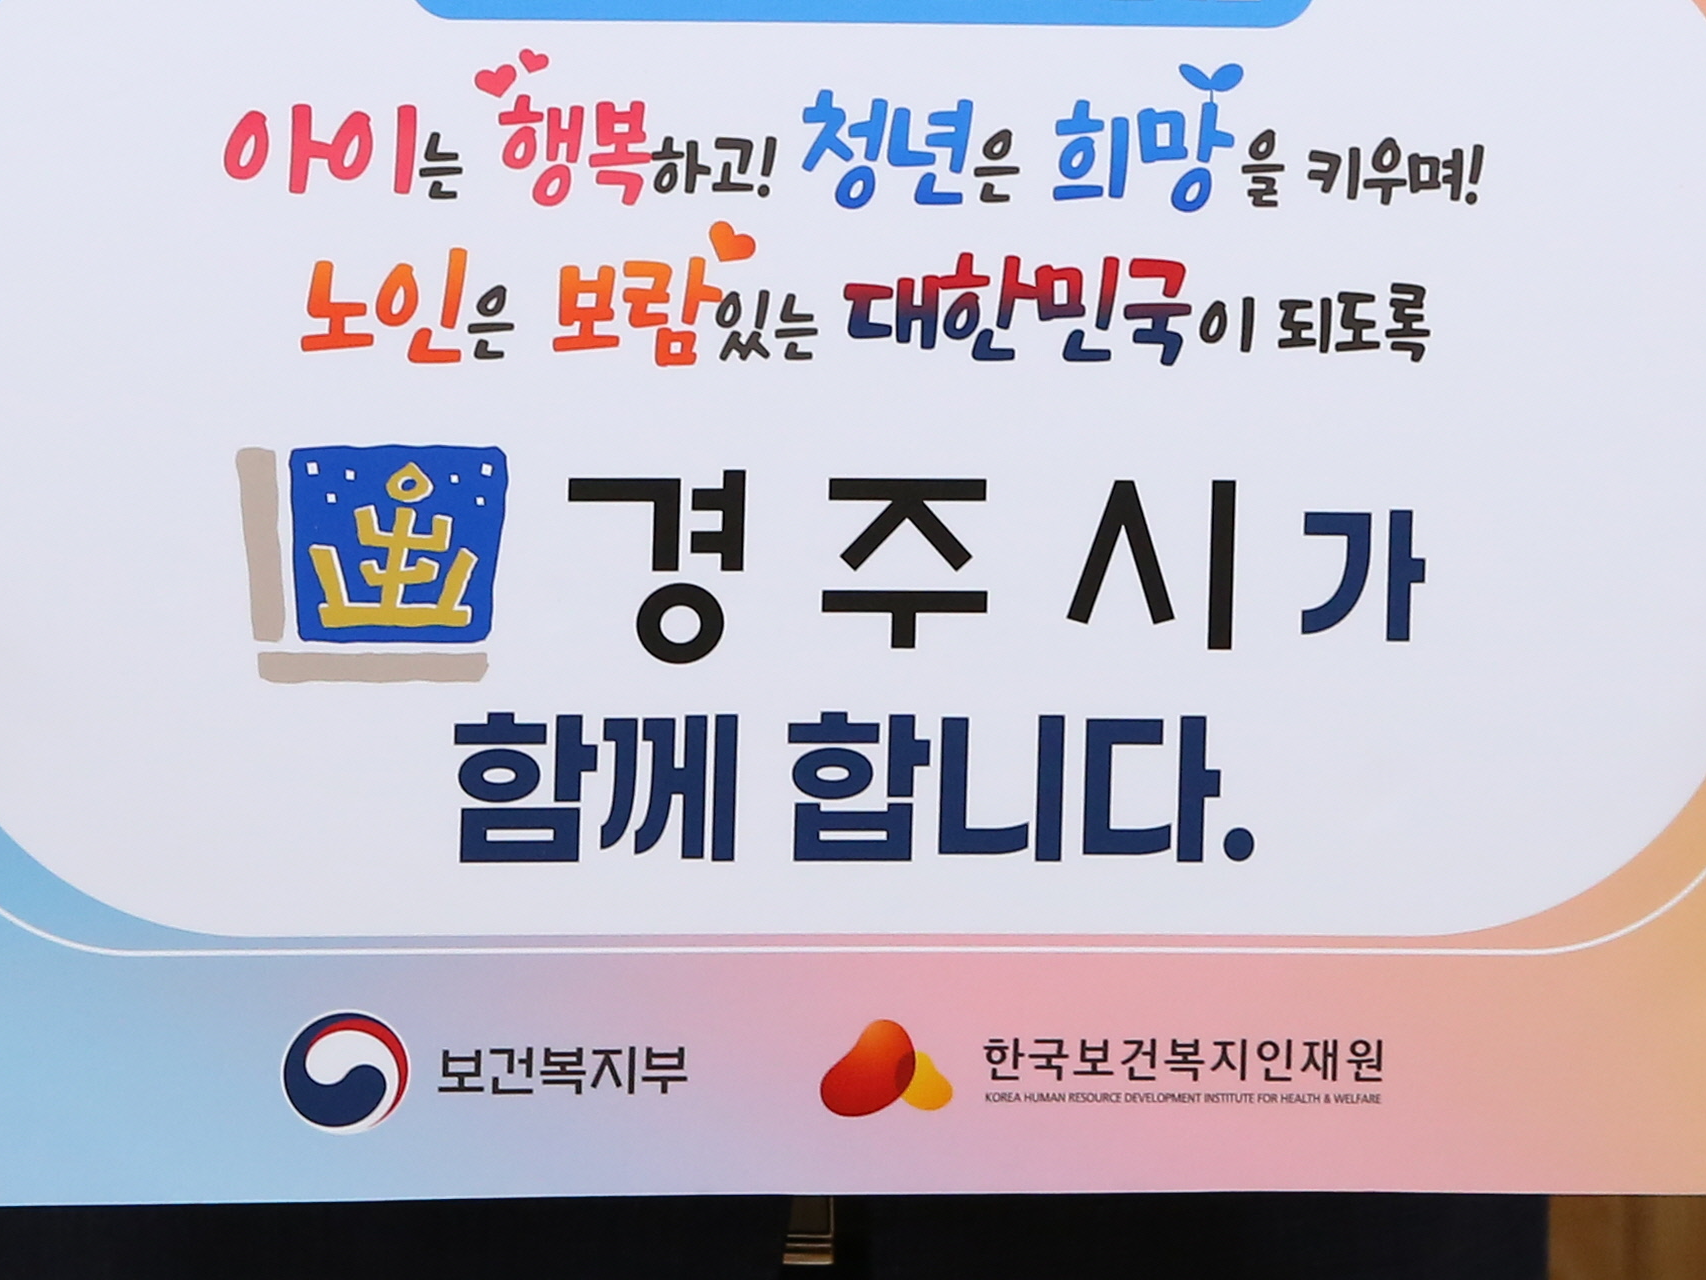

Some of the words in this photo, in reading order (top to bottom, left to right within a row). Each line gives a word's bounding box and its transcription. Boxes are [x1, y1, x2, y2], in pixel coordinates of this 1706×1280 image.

[223, 103, 464, 200] 아이는
[497, 94, 778, 207] 행복하고!
[801, 89, 1021, 210] 청년은
[1052, 100, 1286, 213] 희망을
[1307, 136, 1486, 206] 키우며!
[300, 247, 515, 364] 노인은
[552, 255, 819, 368] 보람있는
[842, 251, 1256, 367] 대한민국이
[1276, 281, 1432, 363] 되도록
[453, 711, 740, 864] 함께
[787, 710, 1256, 864] 합니다.
[436, 1045, 689, 1096] 보건복지부
[983, 1037, 1384, 1083] 한국보건복지인재원
[984, 1092, 1022, 1105] KOREA
[1023, 1092, 1067, 1105] HUMAN
[1067, 1092, 1122, 1105] RESOURCE
[1123, 1092, 1202, 1105] DEVELOPMENT
[1204, 1092, 1255, 1105] INSTITUTE
[1256, 1092, 1279, 1105] FOR
[1279, 1092, 1321, 1105] HEALTH
[1322, 1092, 1332, 1105] &
[1333, 1092, 1382, 1105] WELFARE
